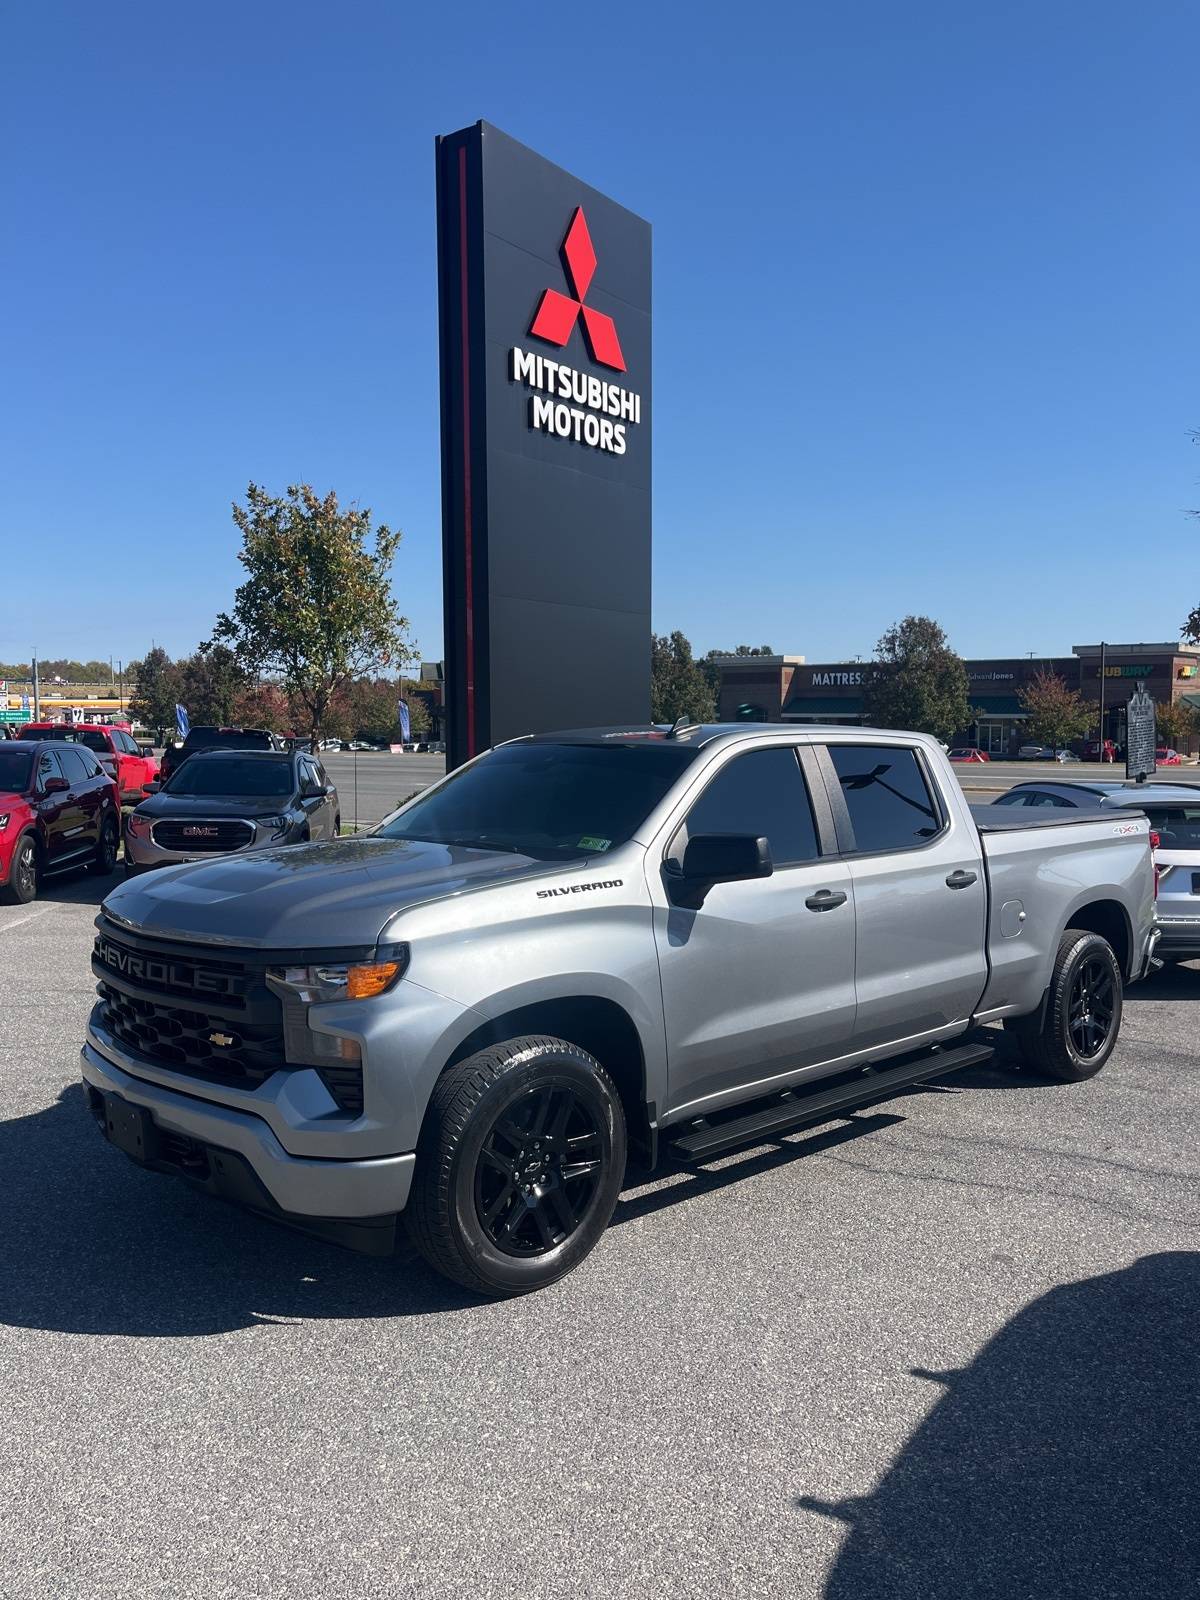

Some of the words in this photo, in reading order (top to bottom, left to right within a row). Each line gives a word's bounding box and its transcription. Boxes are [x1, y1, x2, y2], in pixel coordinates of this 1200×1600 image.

[514, 346, 640, 424] MITSUBISHI
[533, 395, 626, 455] MOTORS
[183, 827, 218, 836] GMC
[536, 879, 624, 899] SILVERADO
